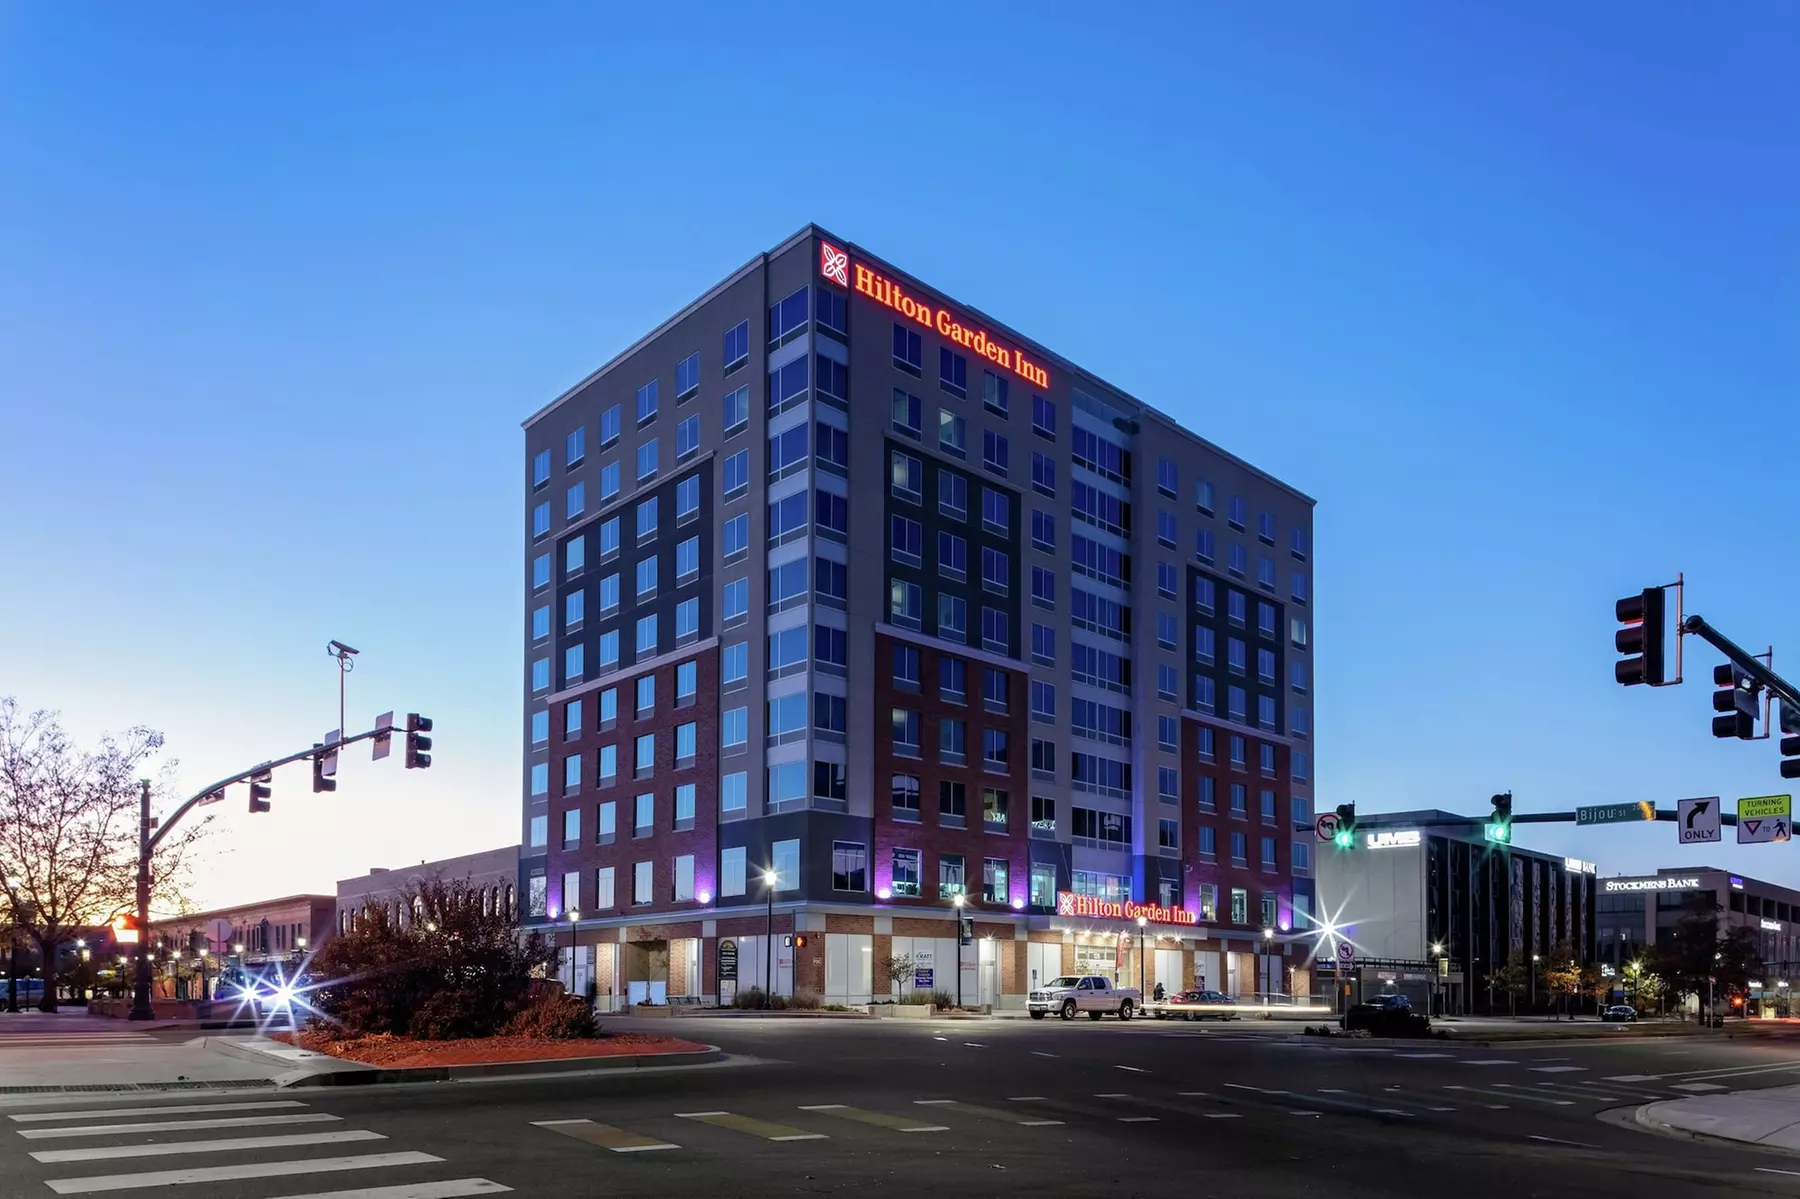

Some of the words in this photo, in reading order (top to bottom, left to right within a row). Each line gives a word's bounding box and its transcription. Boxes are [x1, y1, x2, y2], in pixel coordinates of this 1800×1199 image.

[855, 264, 933, 328] Hilton
[936, 310, 1011, 369] Garden
[1014, 350, 1049, 388] Inn
[1747, 798, 1782, 808] TURNING
[1580, 808, 1614, 822] Bijou
[1744, 807, 1785, 817] VEHICLES
[1684, 829, 1715, 840] ONLY
[1076, 896, 1122, 917] Hilton
[1125, 901, 1171, 920] Garden
[1173, 905, 1196, 923] Inn
